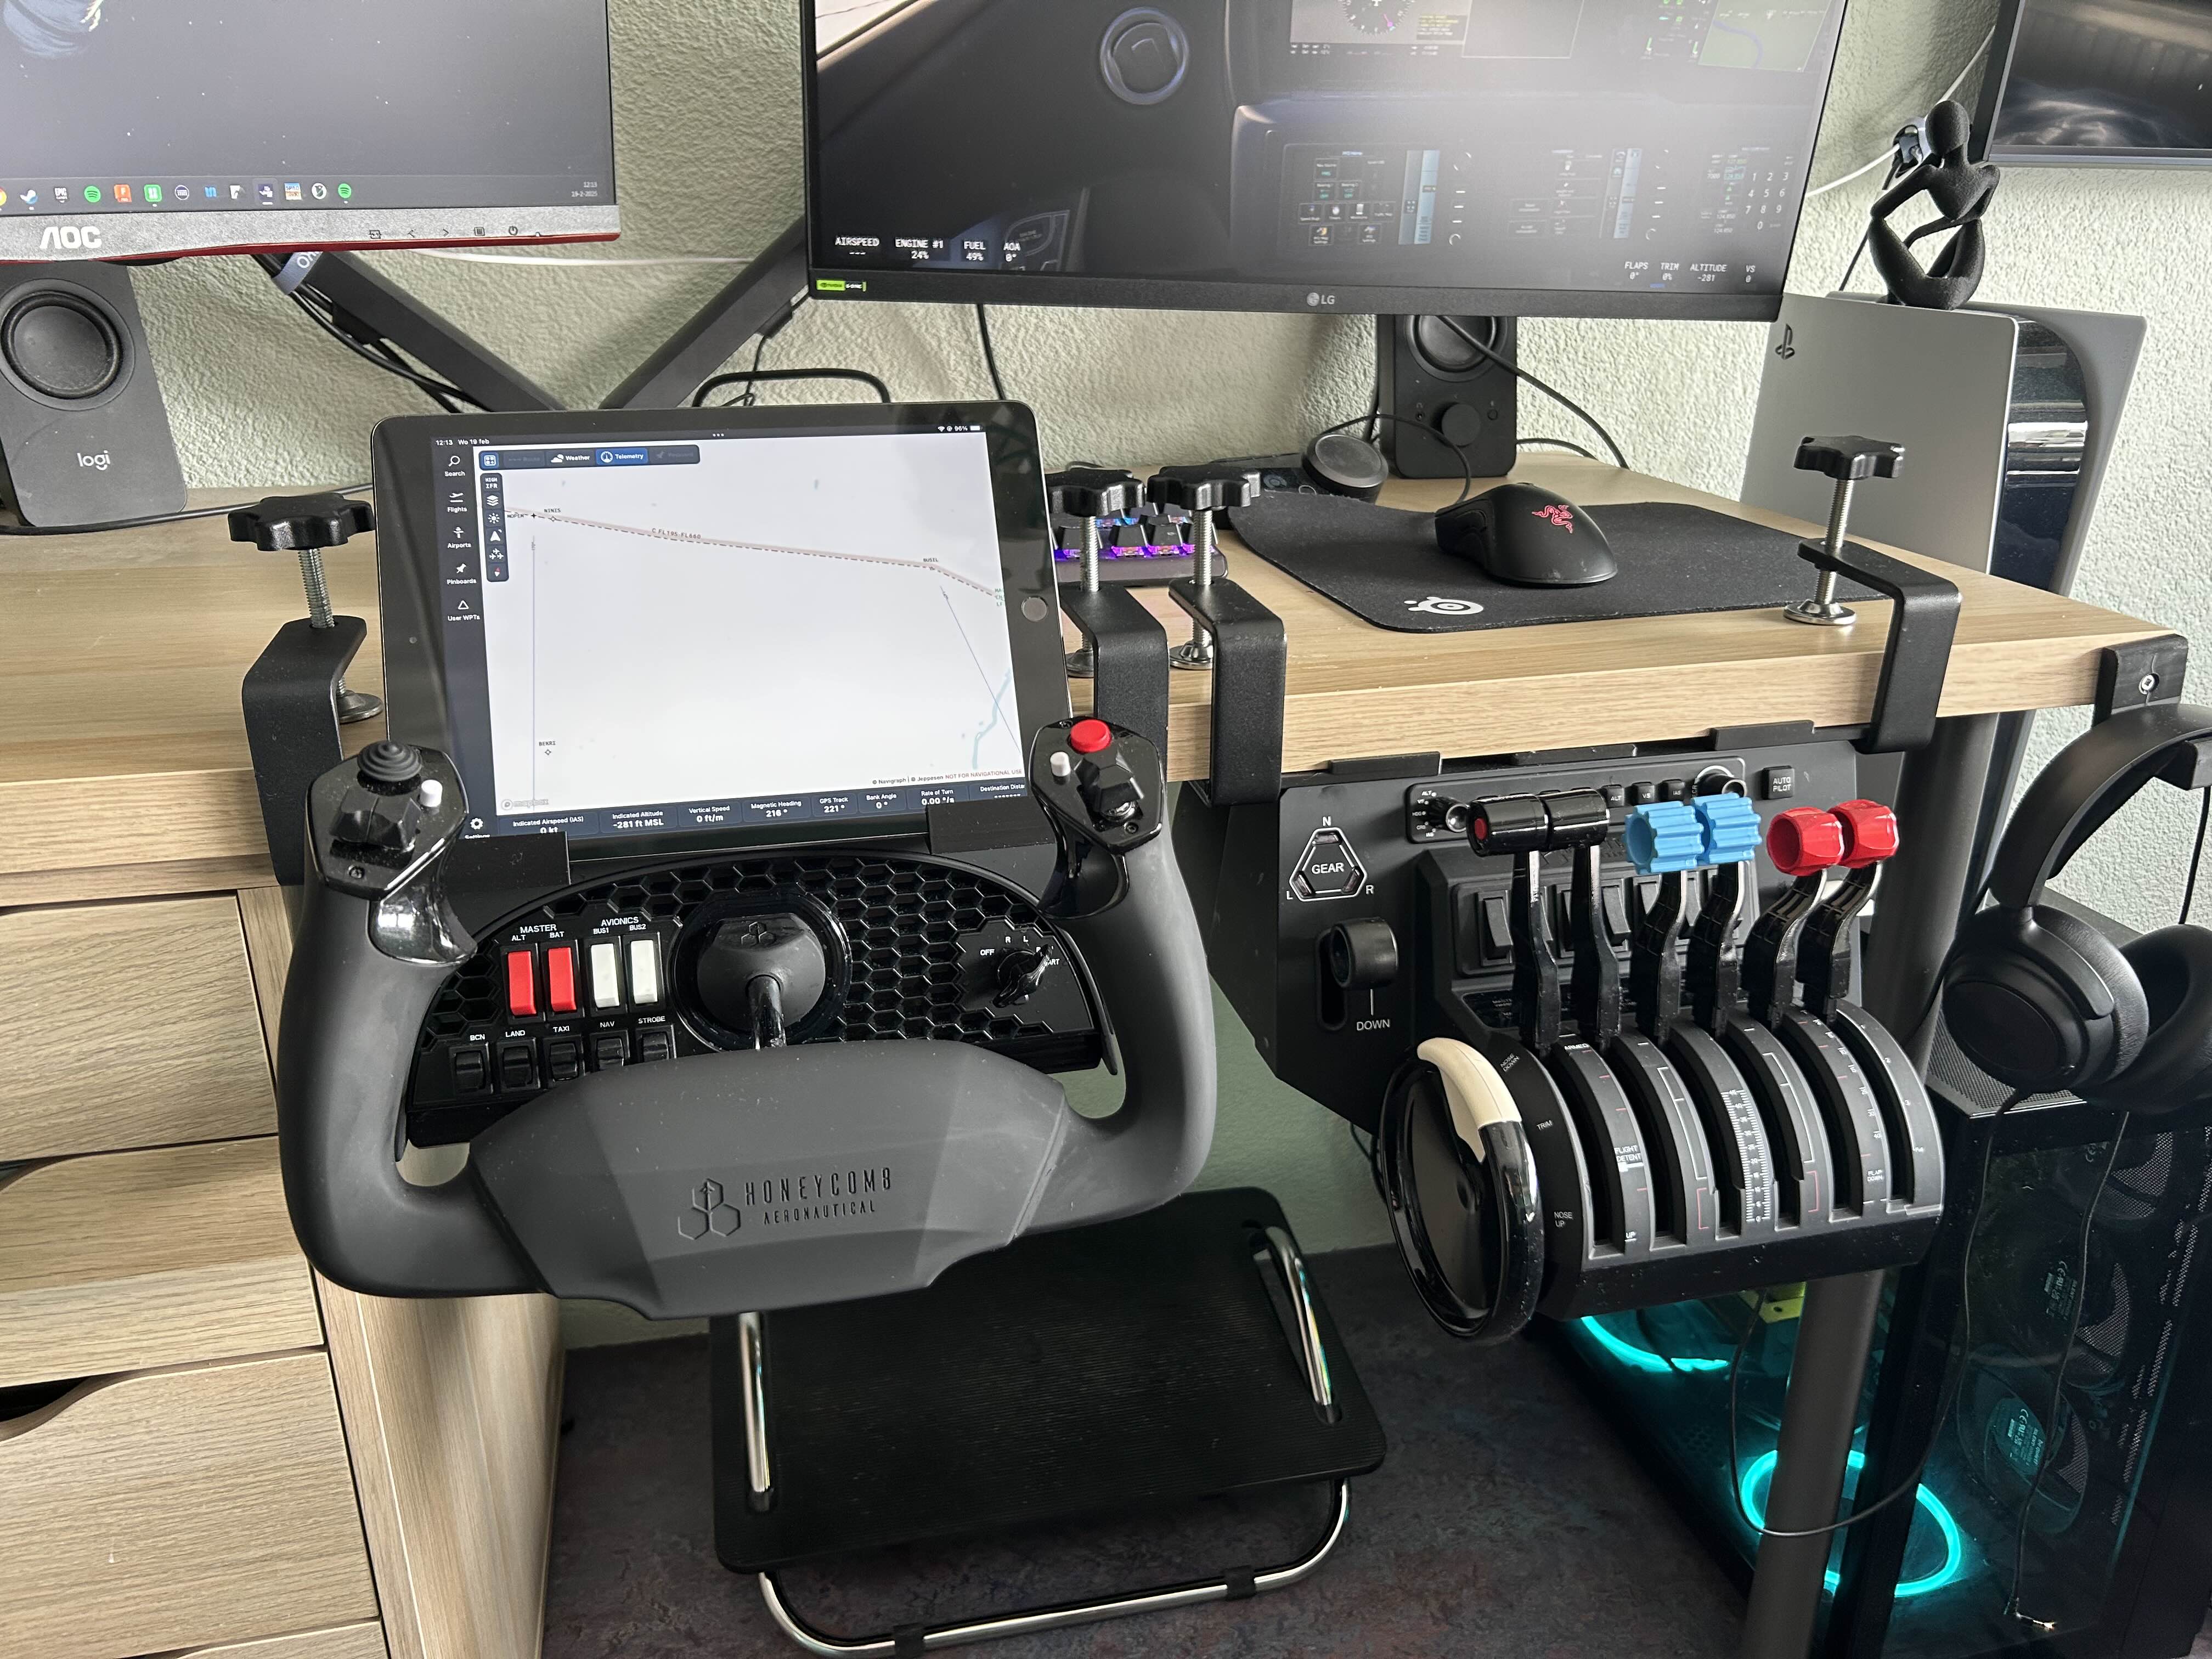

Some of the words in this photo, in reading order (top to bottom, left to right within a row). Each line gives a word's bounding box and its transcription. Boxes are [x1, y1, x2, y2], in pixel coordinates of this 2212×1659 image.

[1753, 173, 1757, 181] 1
[1767, 172, 1773, 181] 2
[1783, 172, 1788, 180] 3
[1748, 189, 1754, 198] 4
[1764, 189, 1769, 198] 5
[1780, 189, 1785, 197] 6
[1746, 205, 1751, 214] 7
[1760, 205, 1767, 214] 8
[1776, 205, 1782, 213] 9
[1758, 221, 1763, 230] 0
[40, 225, 103, 249] AOC
[834, 237, 879, 247] AIRSPEED
[895, 238, 928, 248] ENGINE
[932, 240, 944, 249] #1
[963, 241, 985, 251] FUEL
[1003, 242, 1020, 251] AOA
[911, 251, 929, 259] 24%
[966, 252, 984, 261] 49%
[1624, 261, 1649, 270] FLAPS
[1660, 262, 1681, 270] TRIM
[1689, 263, 1728, 272] ALTITUDE
[1745, 264, 1756, 273] VS
[1697, 274, 1716, 283] -281
[1321, 294, 1335, 306] LG
[77, 450, 110, 471] logi
[1773, 776, 1791, 785] AUTO
[1773, 783, 1792, 792] PILOT
[921, 797, 940, 805] 0.00
[751, 802, 777, 810] Magnetic
[542, 817, 568, 825] Airspeed
[613, 820, 633, 828] -281
[645, 819, 664, 827] MSL
[1322, 816, 1331, 826] N
[1311, 862, 1344, 874] GEAR
[1366, 885, 1374, 894] R
[1286, 890, 1293, 900] L
[601, 917, 640, 927] AVIONICS
[520, 923, 557, 934] MASTER
[638, 1015, 666, 1024] STROBE
[1356, 1019, 1391, 1031] DOWN
[1500, 1053, 1514, 1068] NOSE
[1503, 1056, 1520, 1071] DOWN
[1537, 1120, 1553, 1131] TRIM
[1615, 1145, 1638, 1154] FLIGHT
[1617, 1153, 1641, 1161] DETENT
[744, 1167, 891, 1206] HONEYCOMB
[764, 1200, 875, 1225] AERONAUTICAL
